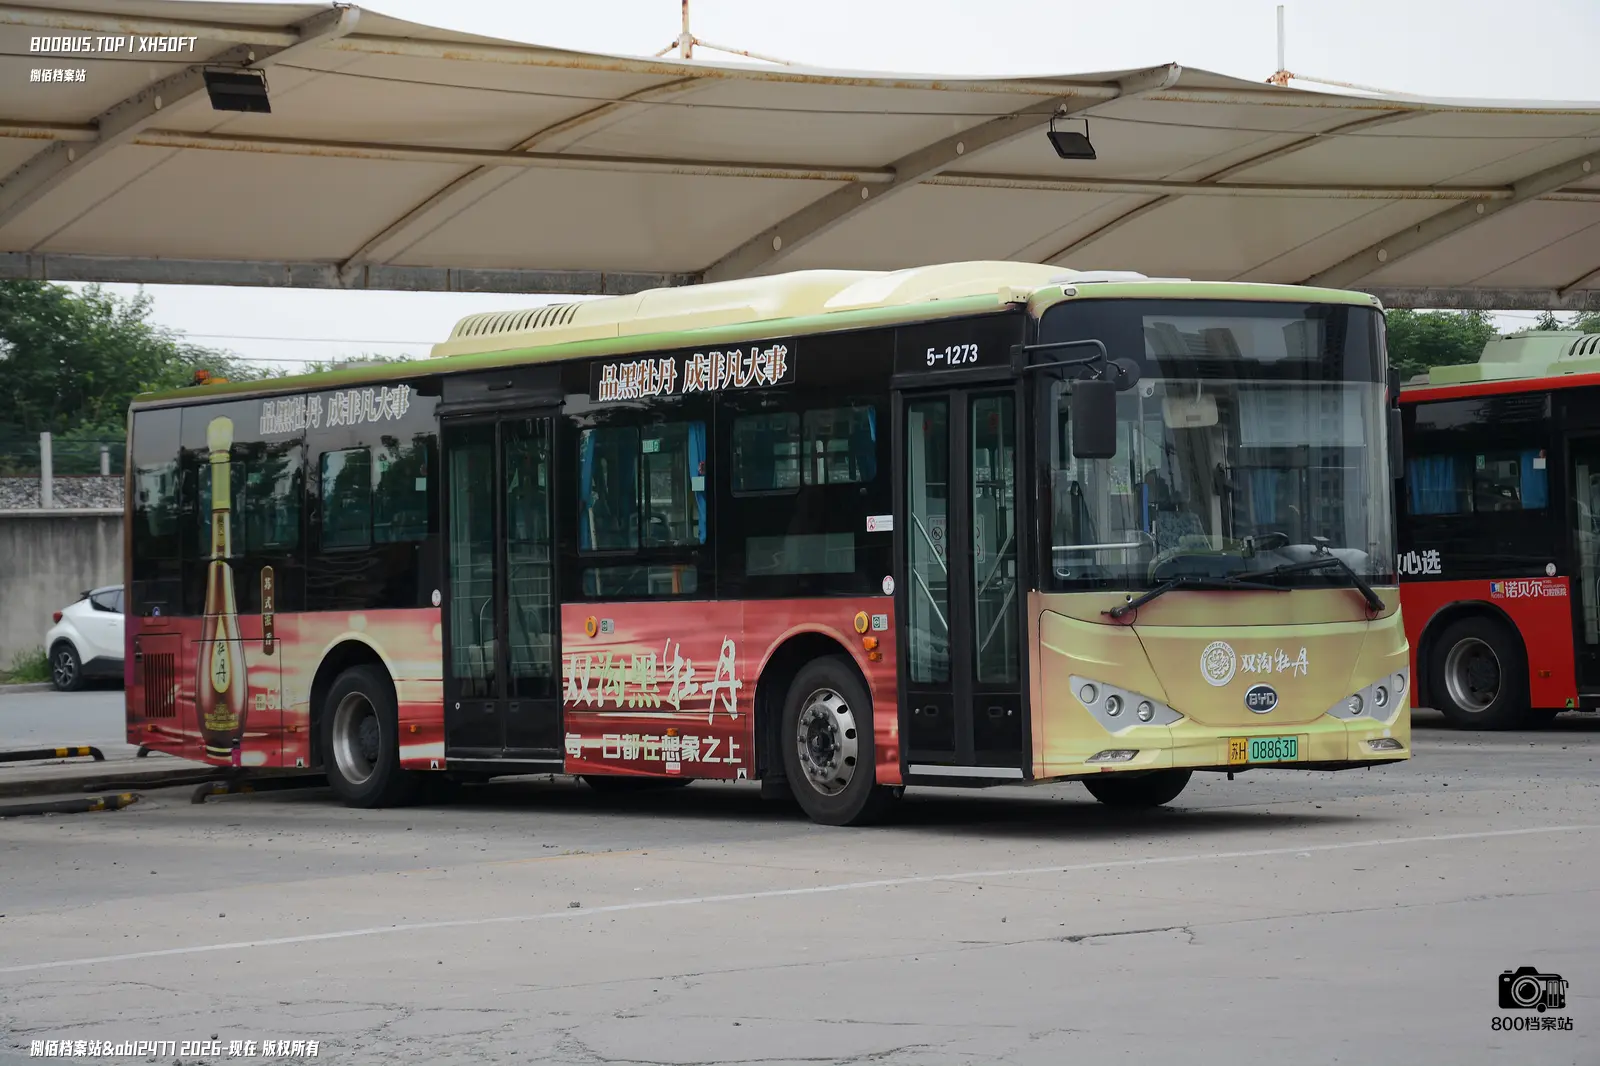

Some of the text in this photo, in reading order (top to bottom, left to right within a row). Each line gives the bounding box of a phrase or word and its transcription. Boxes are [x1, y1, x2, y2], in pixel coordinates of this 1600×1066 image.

[926, 343, 979, 367] 5-1273
[598, 344, 788, 402] 品黑牡丹 成非凡大事
[259, 384, 410, 435] 品黑牡丹 成非凡大事
[1397, 549, 1442, 575] 心选
[1504, 580, 1543, 598] 诺贝尔
[1241, 646, 1309, 678] 双沟牡丹
[563, 635, 743, 725] 双沟黑牡丹
[1248, 693, 1275, 705] BYD
[565, 732, 742, 764] 每一口都在想象之上
[1231, 739, 1297, 761] 苏H 08863D
